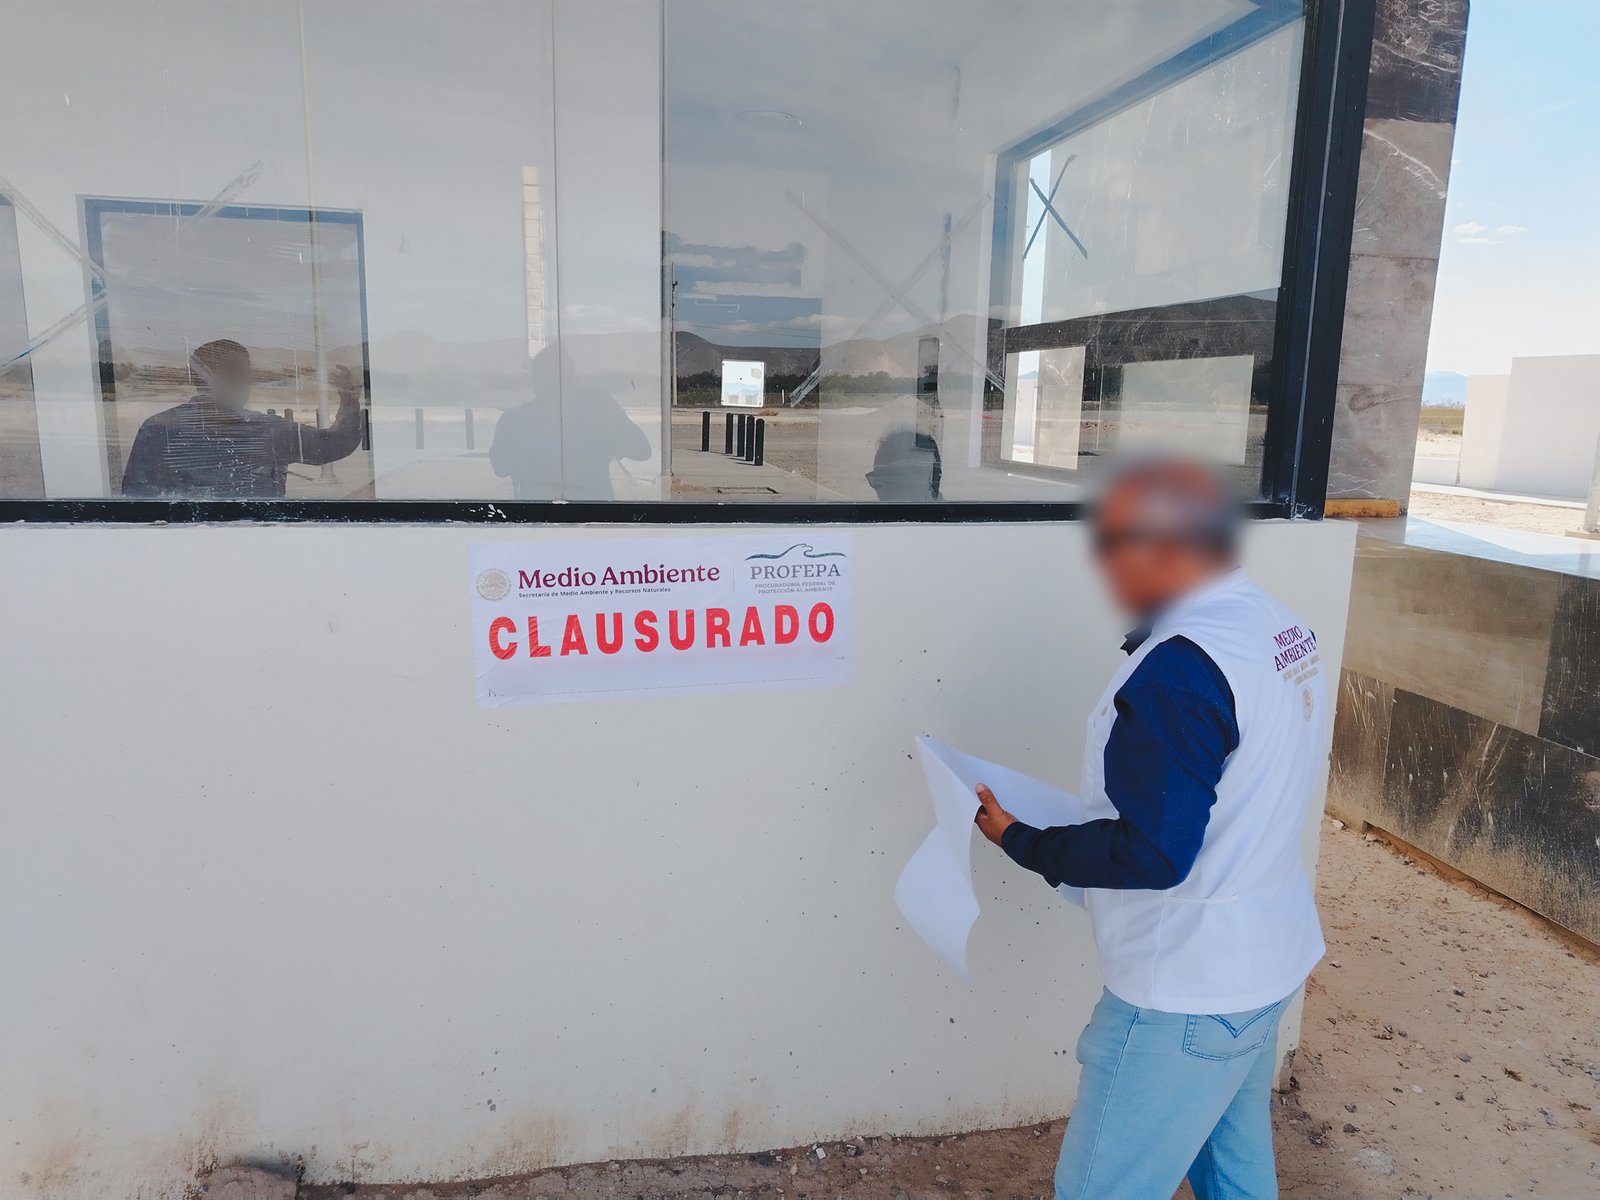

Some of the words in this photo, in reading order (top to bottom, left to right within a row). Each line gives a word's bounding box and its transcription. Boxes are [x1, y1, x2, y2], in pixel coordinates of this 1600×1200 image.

[518, 567, 597, 589] Medio
[601, 564, 720, 586] Ambiente
[750, 563, 841, 580] PROFEPA
[580, 588, 608, 596] Ambiente
[488, 602, 835, 661] CLAUSURADO
[1273, 625, 1303, 649] MEDIO
[1274, 636, 1317, 672] AMBIENTE
